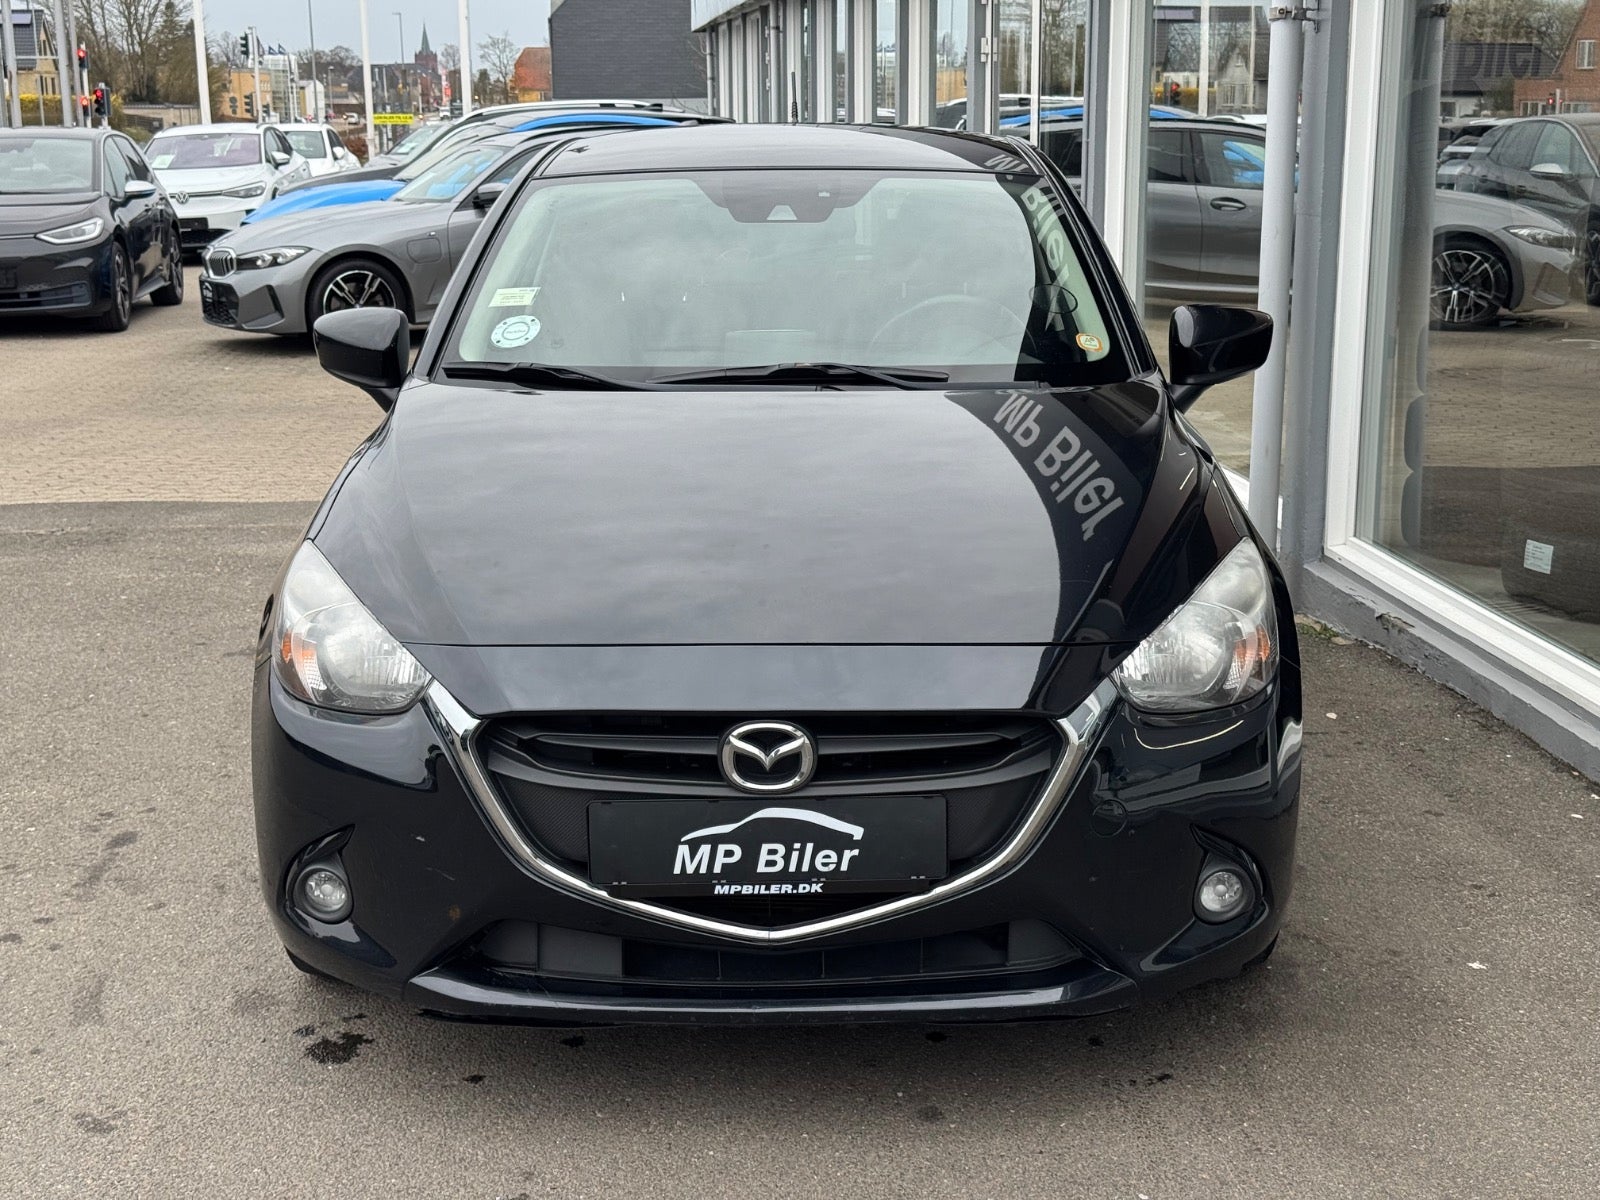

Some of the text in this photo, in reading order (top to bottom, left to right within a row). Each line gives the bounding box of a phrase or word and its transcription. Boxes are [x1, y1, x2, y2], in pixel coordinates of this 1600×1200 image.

[673, 842, 859, 874] MP Biler
[714, 883, 823, 895] MPBILER.DK
